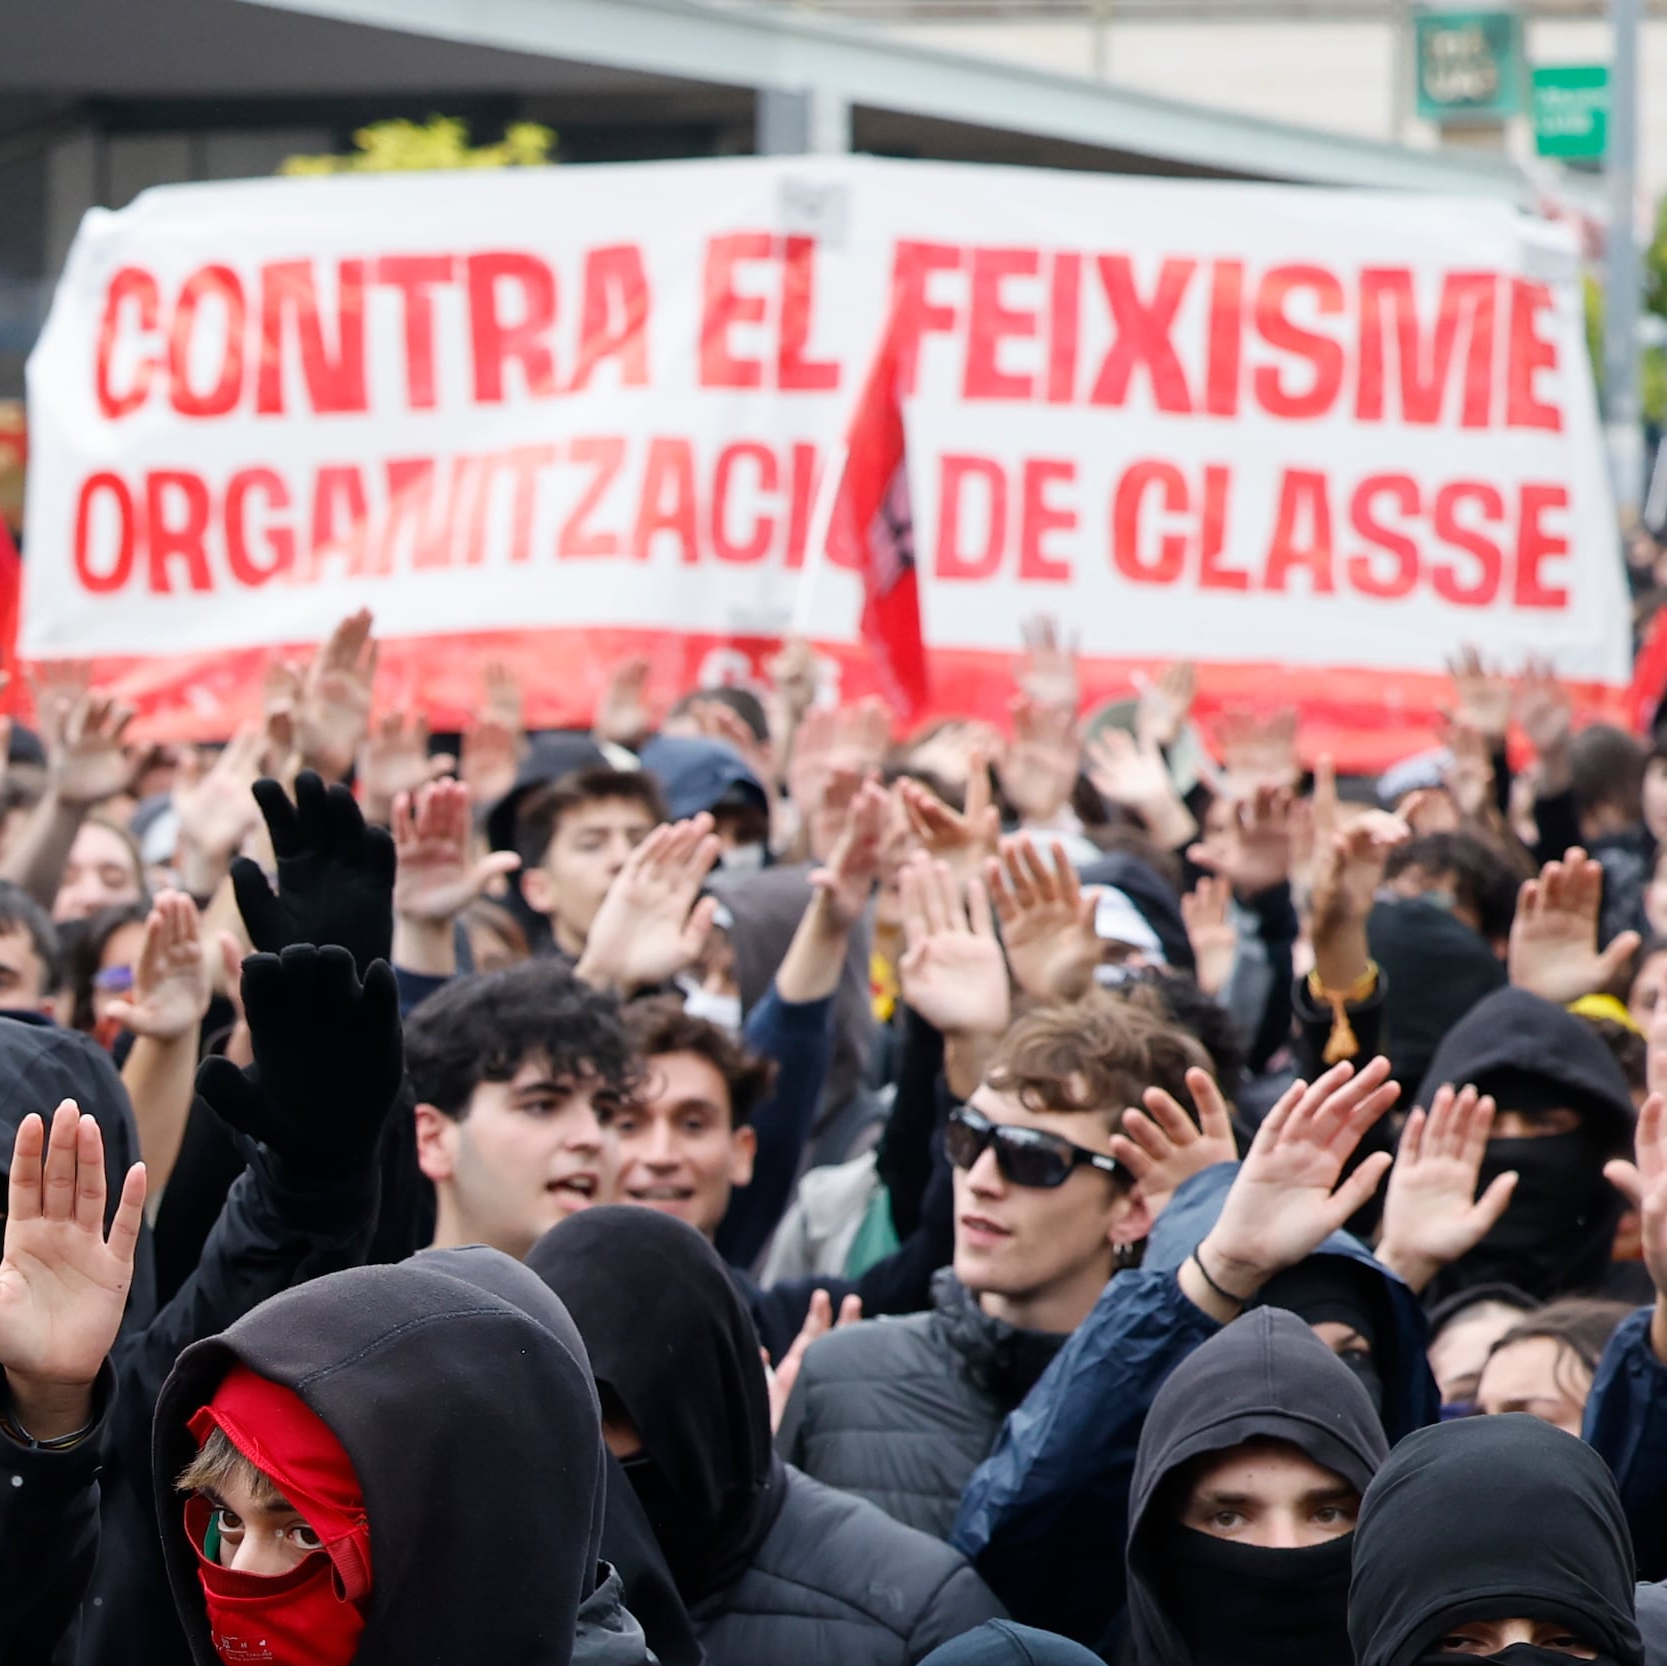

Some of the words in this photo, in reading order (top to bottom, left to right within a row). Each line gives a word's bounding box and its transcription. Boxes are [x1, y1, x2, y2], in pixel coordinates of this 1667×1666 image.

[93, 247, 652, 420] CONTRA
[697, 232, 840, 391] EL
[893, 239, 1563, 433] FEIXISME
[934, 455, 1076, 583] DE
[1110, 457, 1569, 609] CLASSE
